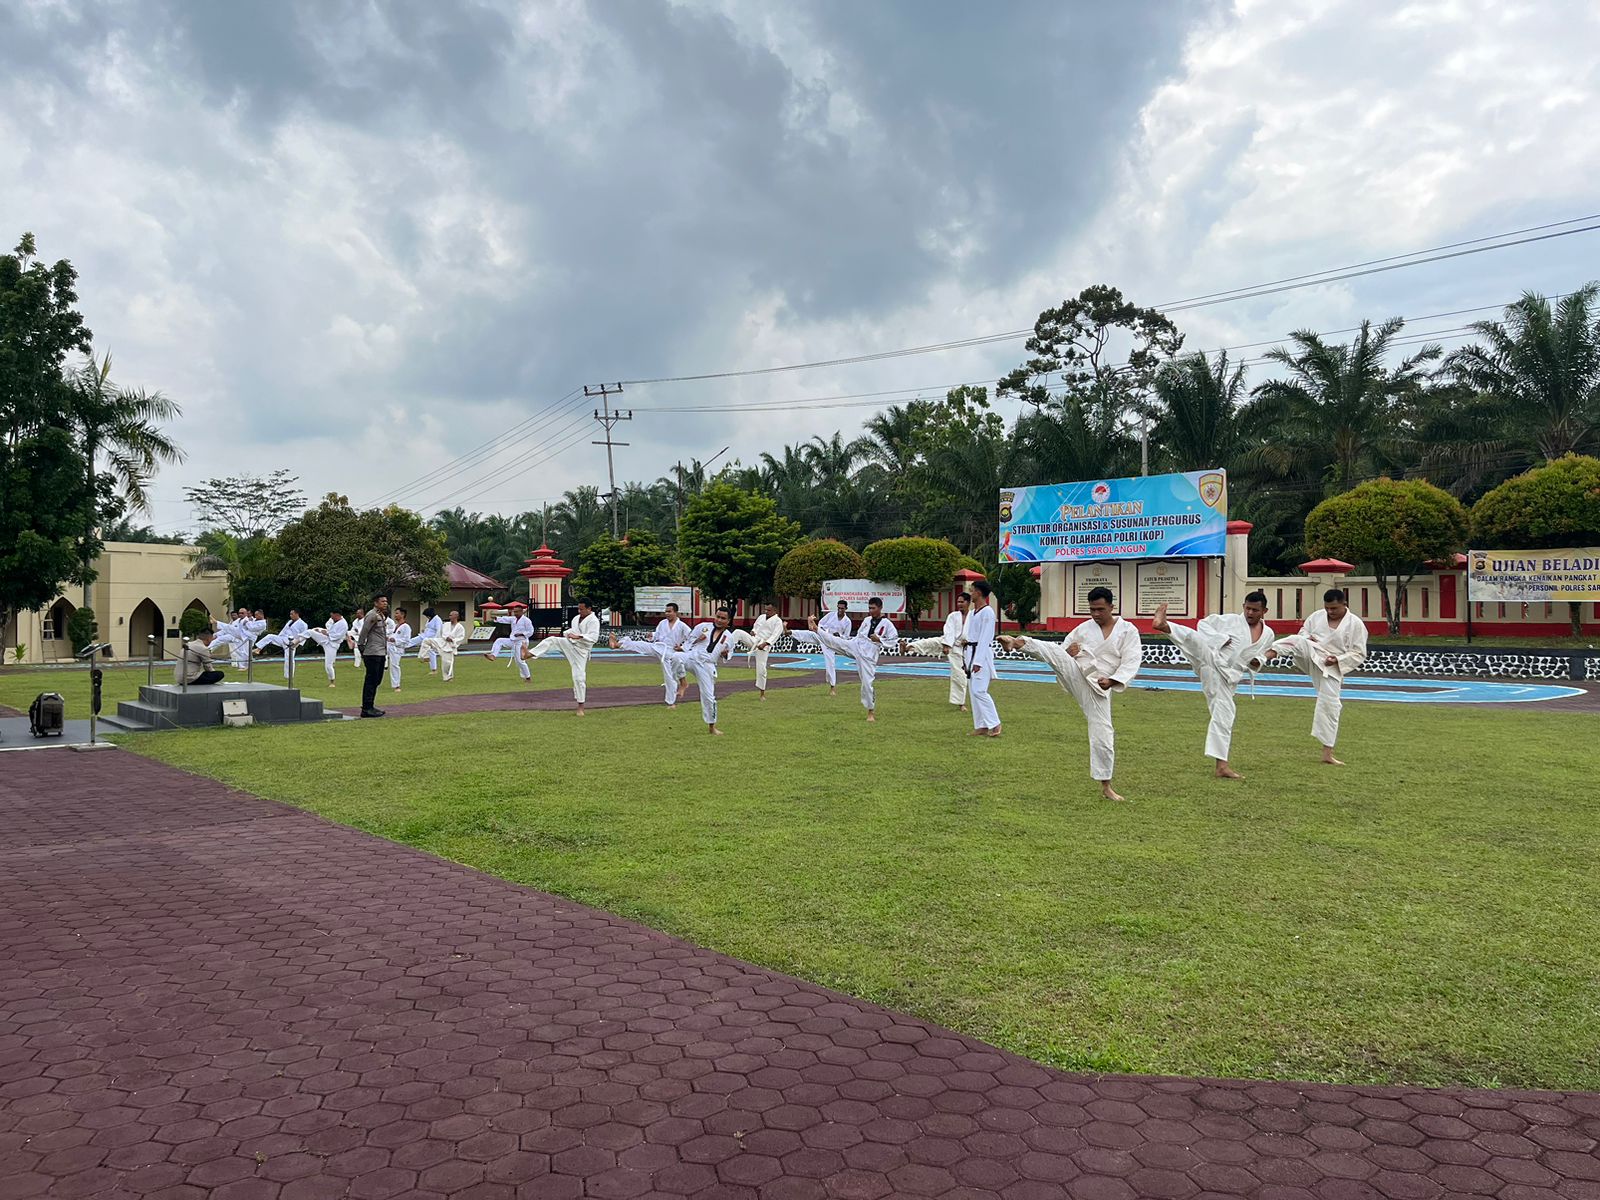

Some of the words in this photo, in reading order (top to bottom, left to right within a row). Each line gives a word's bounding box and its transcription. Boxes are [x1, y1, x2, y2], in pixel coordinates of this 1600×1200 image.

[1060, 501, 1143, 521] PELANTIKAN
[1012, 524, 1053, 535] STRUKTUR
[1053, 521, 1101, 532] ORGANISASI
[1103, 522, 1108, 530] &
[1111, 517, 1150, 529] SUSUNAN
[1152, 514, 1201, 526] PENGURUS
[1040, 536, 1069, 546] KOMITE
[1071, 535, 1112, 545] OLAHRAGA
[1114, 532, 1138, 542] POLRI
[1055, 547, 1085, 556] POLRES
[1087, 545, 1146, 555] SAROLANGUN
[1492, 560, 1536, 572] UJIAN
